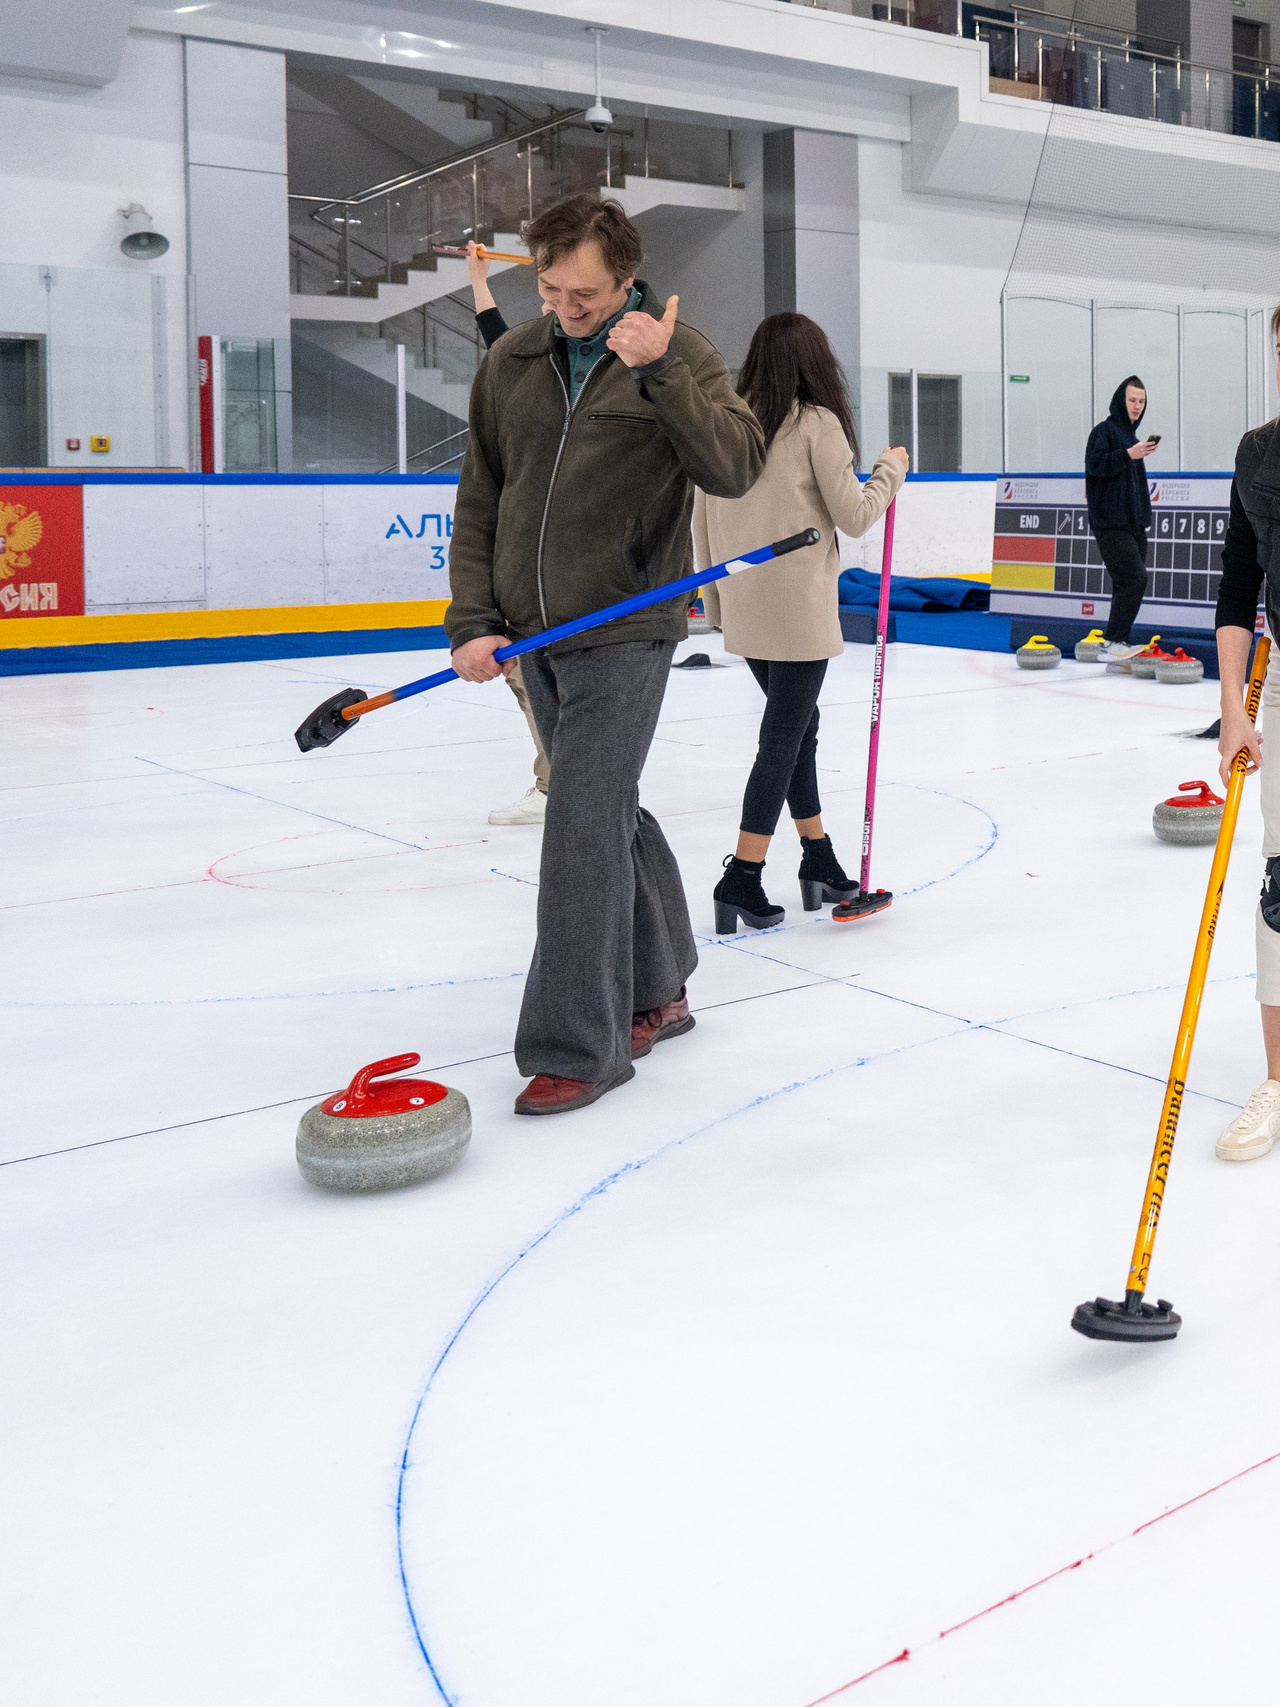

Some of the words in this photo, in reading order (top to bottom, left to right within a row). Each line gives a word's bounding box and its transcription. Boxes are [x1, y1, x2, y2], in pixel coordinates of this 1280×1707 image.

[1020, 514, 1040, 529] END
[1077, 516, 1084, 530] 1
[1161, 518, 1169, 533] 6
[1179, 518, 1187, 533] 7
[1197, 518, 1206, 534] 8
[1216, 519, 1225, 534] 9
